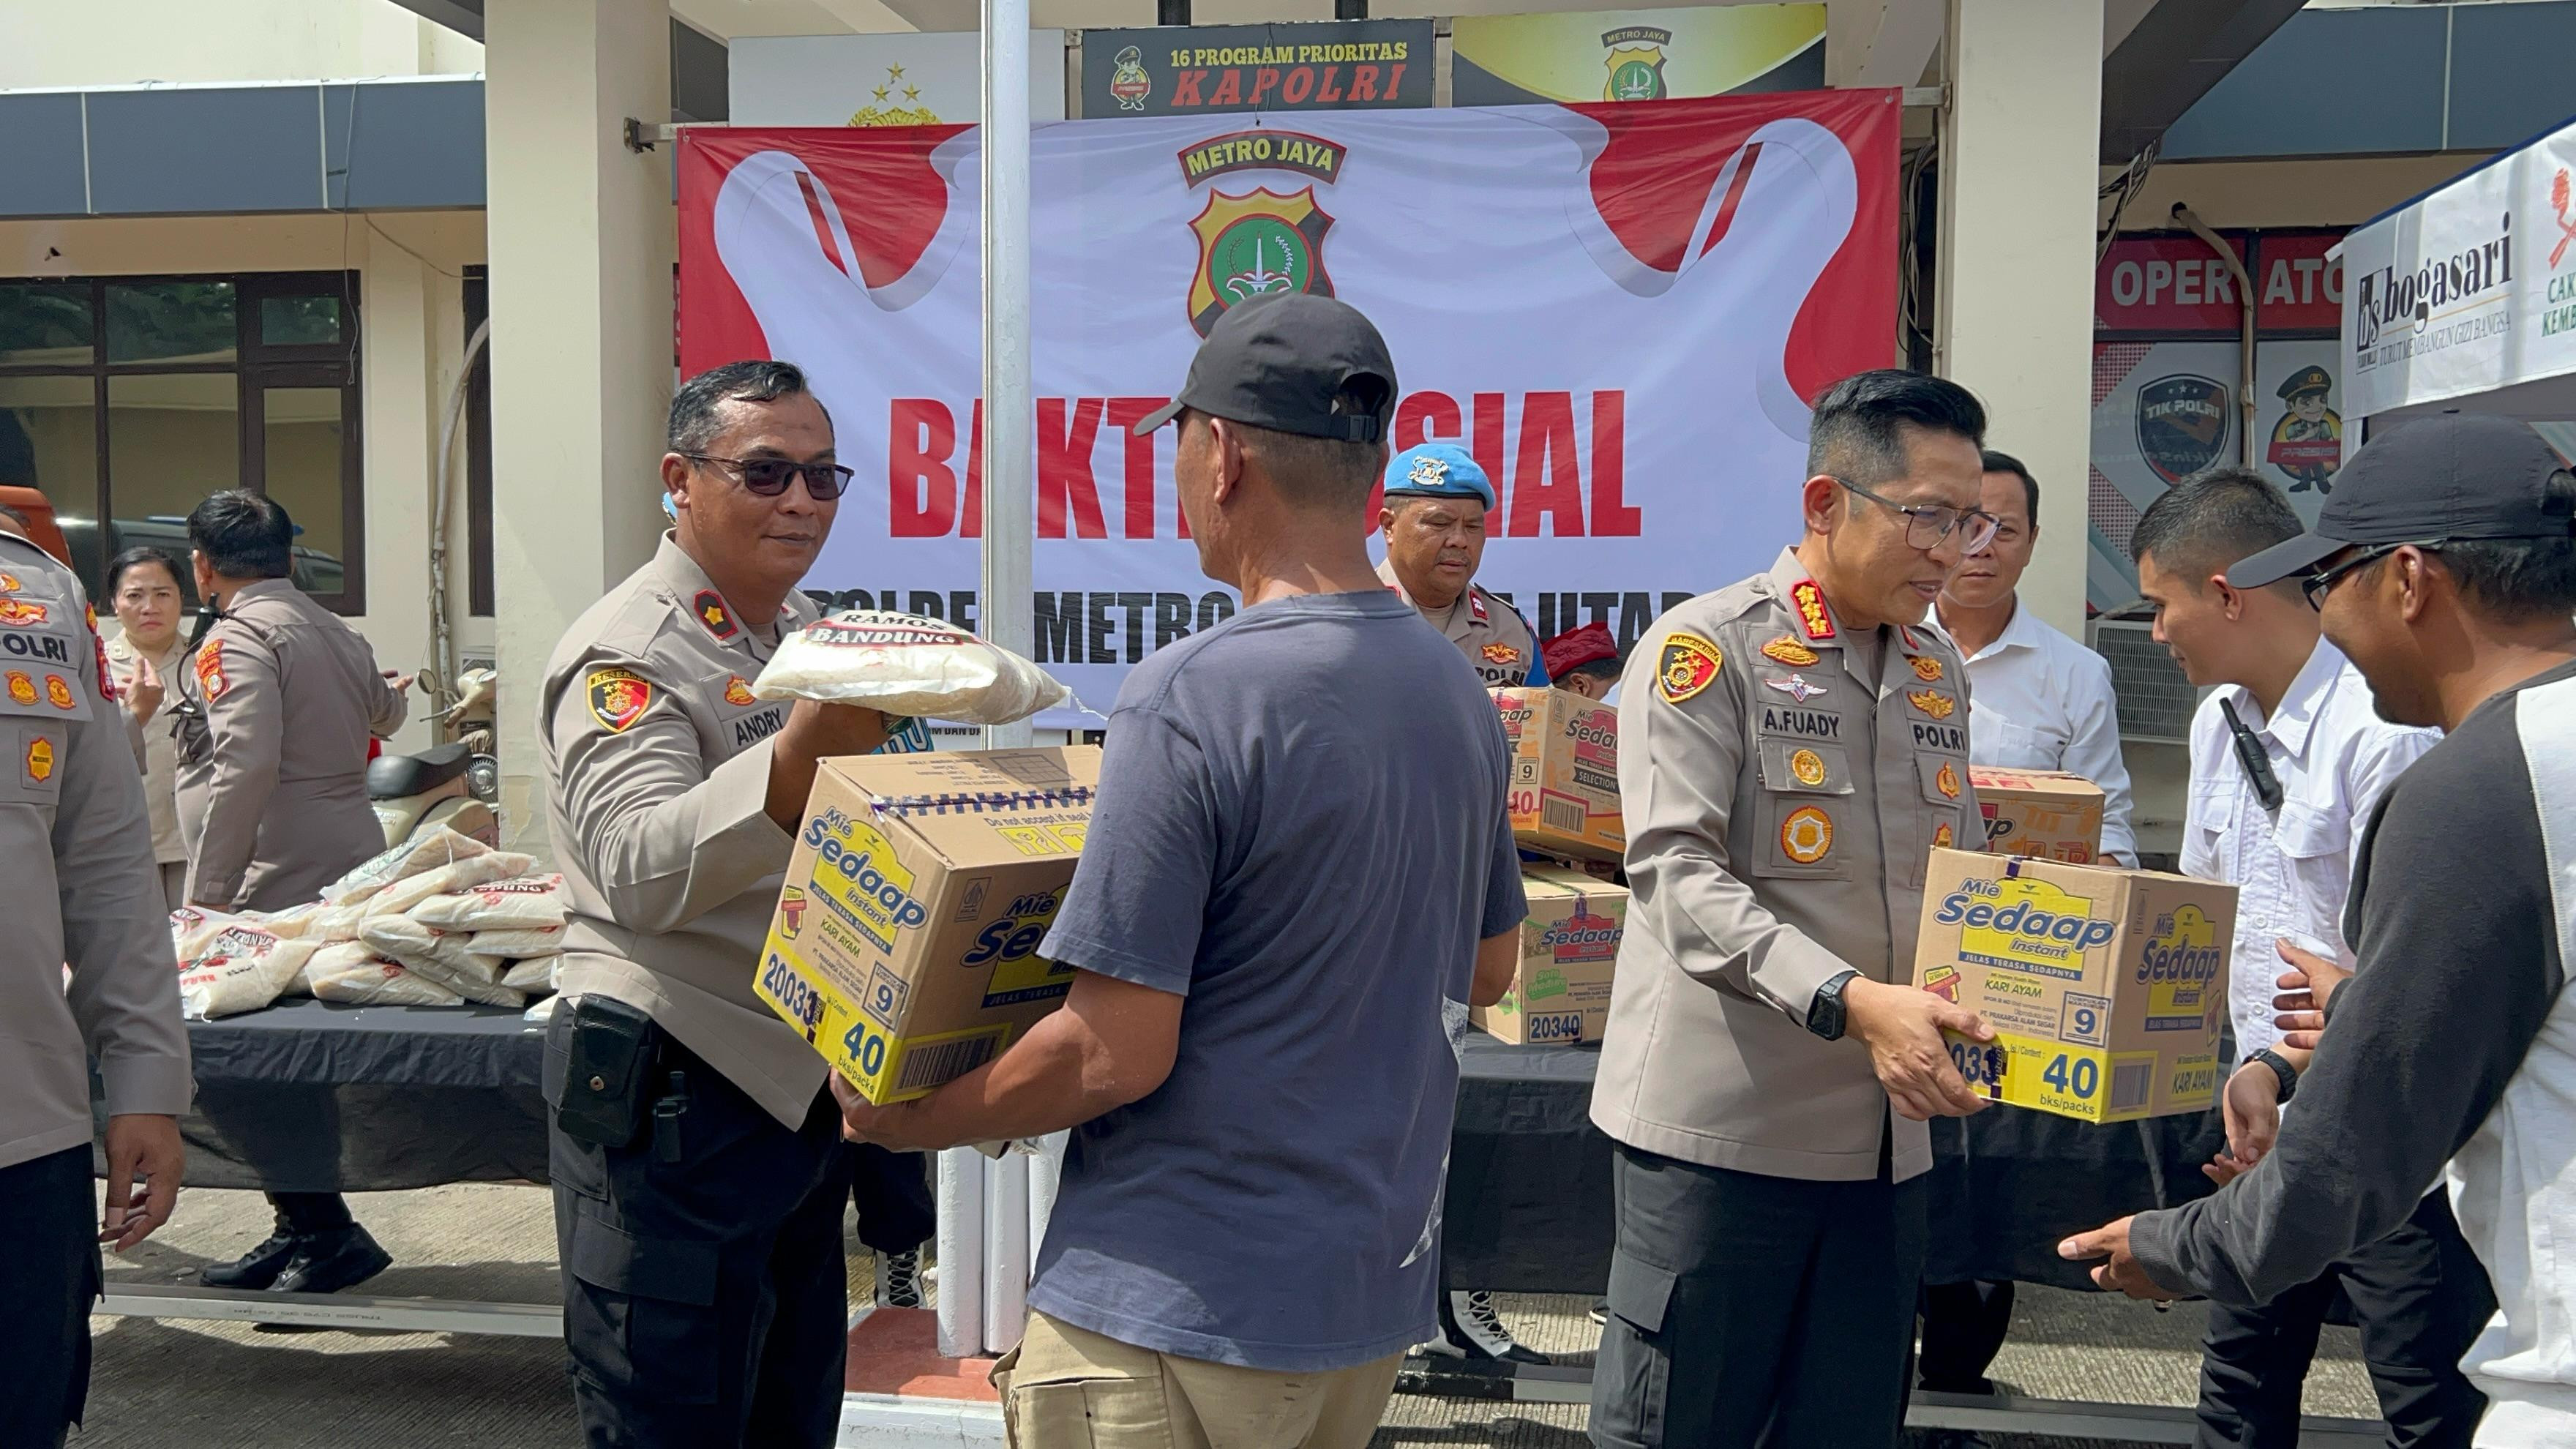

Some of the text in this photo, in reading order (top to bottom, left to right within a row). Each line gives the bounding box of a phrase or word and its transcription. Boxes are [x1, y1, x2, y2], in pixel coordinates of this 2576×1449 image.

[1607, 30, 1665, 42] METRO JAYA
[1171, 41, 1407, 67] 16 PROGRAM PRIORITAS
[1170, 64, 1407, 107] KAPOLRI
[1186, 138, 1334, 176] METRO JAYA
[2381, 211, 2513, 335] bogasari
[2146, 399, 2220, 421] TIK POLRI
[842, 613, 948, 631] RAMOS
[0, 633, 68, 663] OLRI
[810, 627, 956, 645] BANDUNG
[735, 708, 784, 746] ANDRY
[1577, 710, 1594, 722] Mie
[1764, 708, 1839, 738] A.FUADY
[1913, 724, 1966, 752] POLRI
[1522, 765, 1532, 779] 9
[1579, 771, 1617, 790] SELECTION
[826, 808, 853, 836] Mie
[984, 817, 1003, 827] Do
[1003, 816, 1022, 826] not
[1023, 814, 1055, 826] accept
[1056, 812, 1067, 822] if
[1068, 812, 1087, 821] seal
[804, 817, 927, 928] Sedaap
[1961, 880, 2000, 898] Mie
[812, 883, 830, 903] JELAS
[831, 899, 854, 924] TERASA
[854, 918, 887, 953] SEDAPNYA
[847, 888, 888, 927] Instant
[1005, 894, 1057, 917] Mie
[1540, 926, 1624, 947] Sedaap
[1935, 894, 2115, 952] Sedaap
[2154, 914, 2175, 937] Mie
[820, 916, 839, 940] KARI
[838, 932, 861, 959] AYAM
[2012, 940, 2068, 959] Instant
[1964, 953, 2076, 978] JELAS TERASA SEDAPNYA
[2137, 935, 2220, 990] Sedaap
[875, 984, 894, 1013] 9
[1985, 979, 2043, 999] KARI AYAM
[2074, 1008, 2096, 1035] 9
[842, 1022, 885, 1077] 40
[2021, 1046, 2041, 1058] Content
[838, 1054, 875, 1095] bks/packs
[2043, 1053, 2099, 1099] 40
[2171, 1068, 2214, 1095] KARI AYAM
[2040, 1093, 2095, 1115] bks/packs
